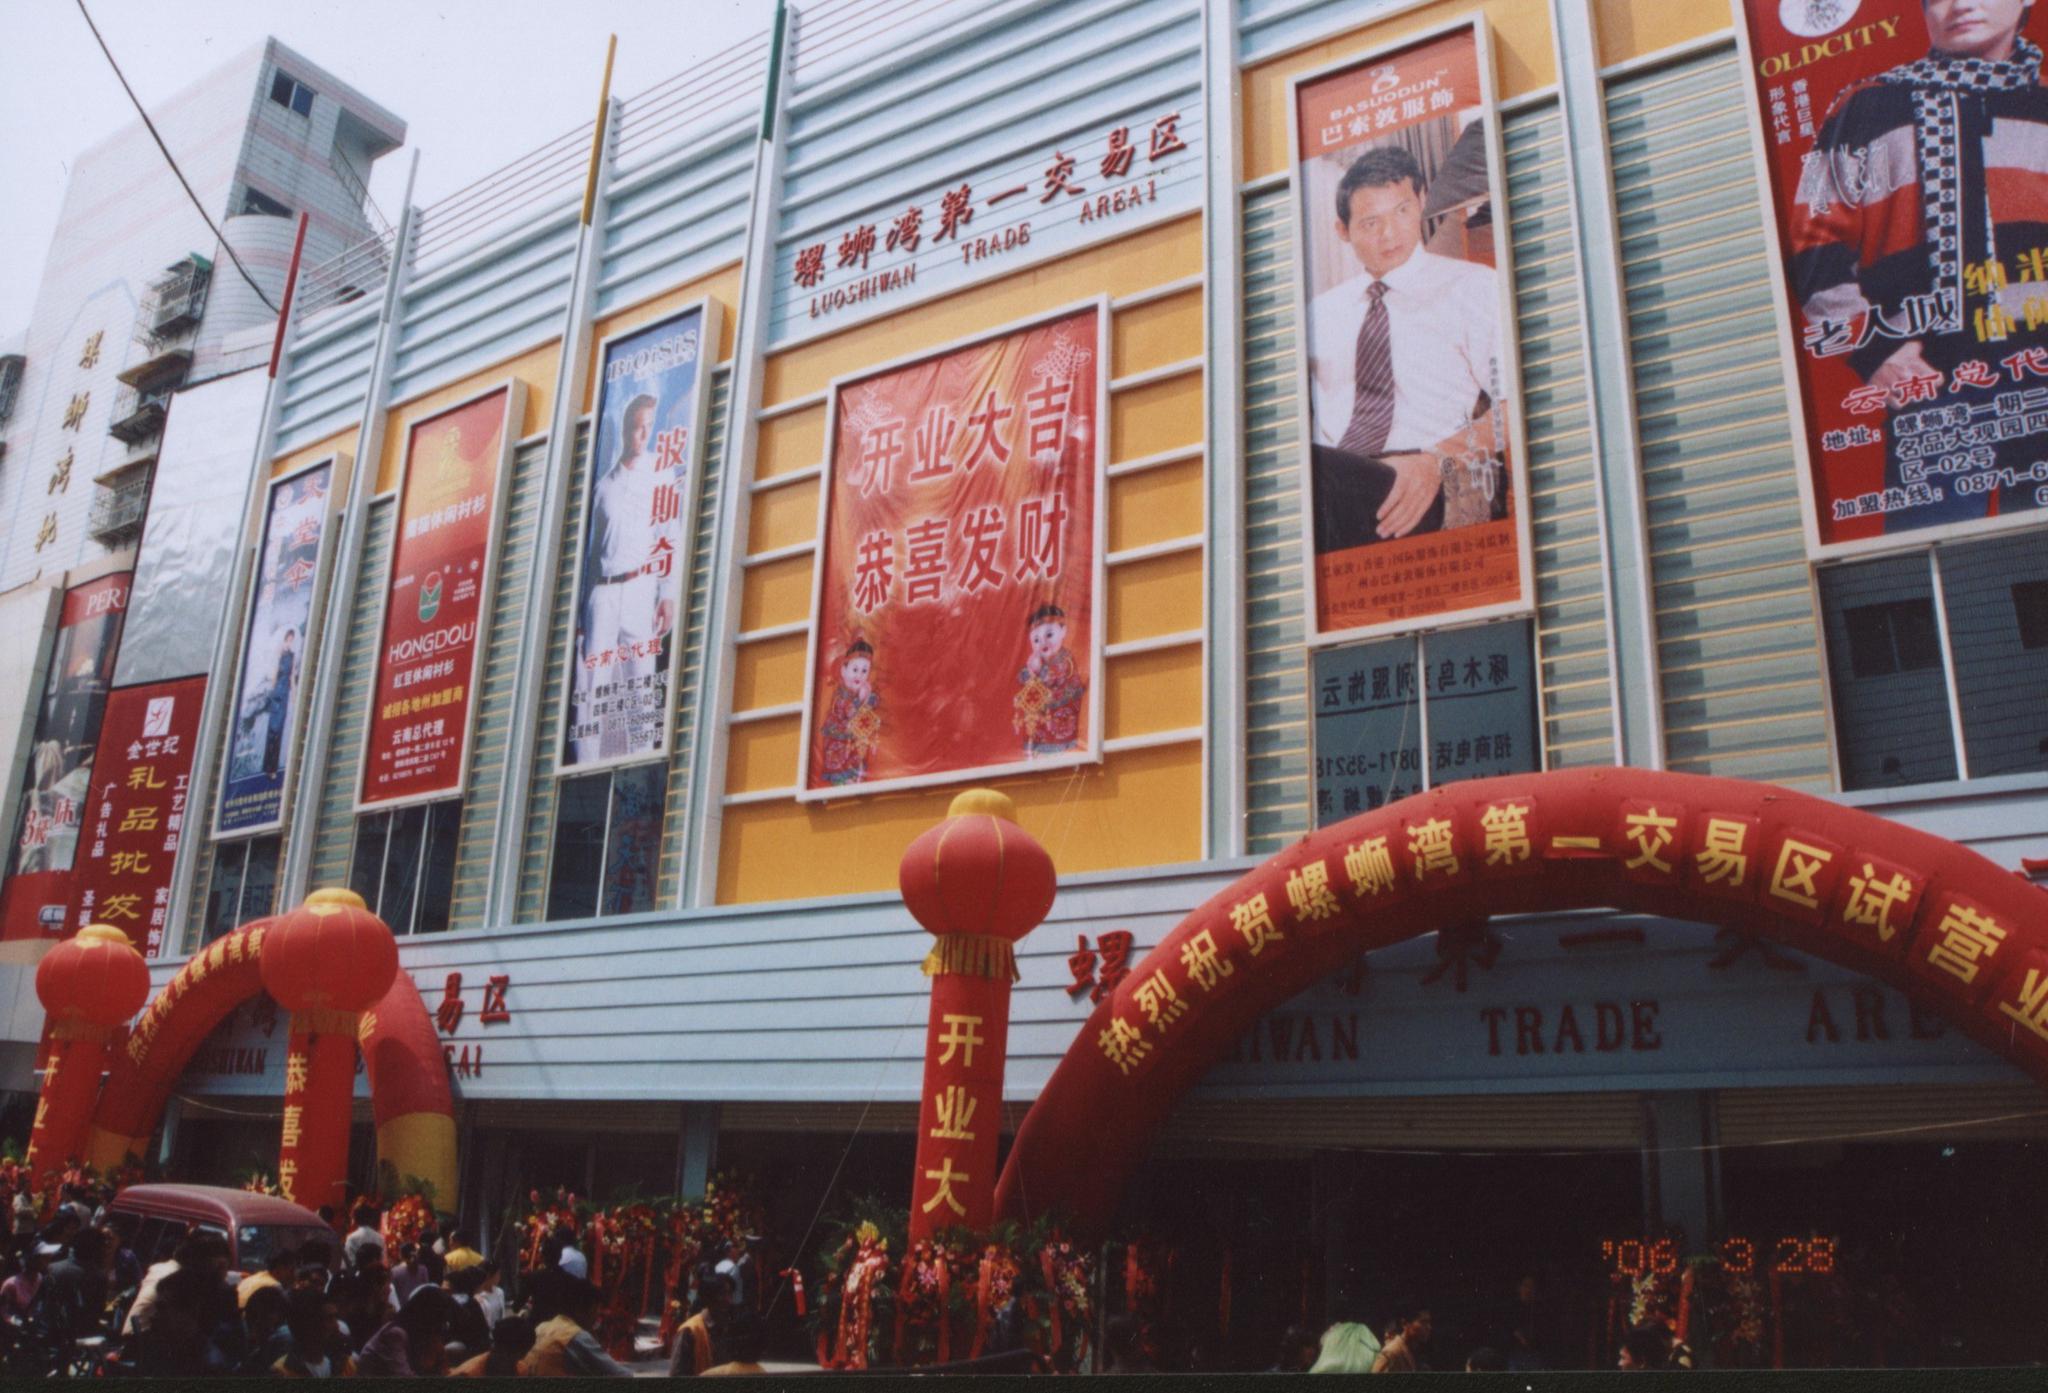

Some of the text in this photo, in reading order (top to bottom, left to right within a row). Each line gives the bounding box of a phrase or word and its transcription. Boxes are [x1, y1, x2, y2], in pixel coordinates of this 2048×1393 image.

[1759, 15, 1901, 78] OLDCITY
[793, 111, 1187, 289] 螺蛳湾第一交易区
[808, 263, 917, 319] LUOSHIWAN
[961, 222, 1031, 265] TRADE
[860, 373, 1073, 499] 开业大吉
[648, 427, 688, 579] 波斯奇
[853, 490, 1070, 616] 恭喜发财
[387, 621, 475, 664] HONGDOU
[91, 782, 117, 858] 广告礼品
[1480, 1000, 1664, 1057] TRADE
[922, 1014, 984, 1217] 开业大
